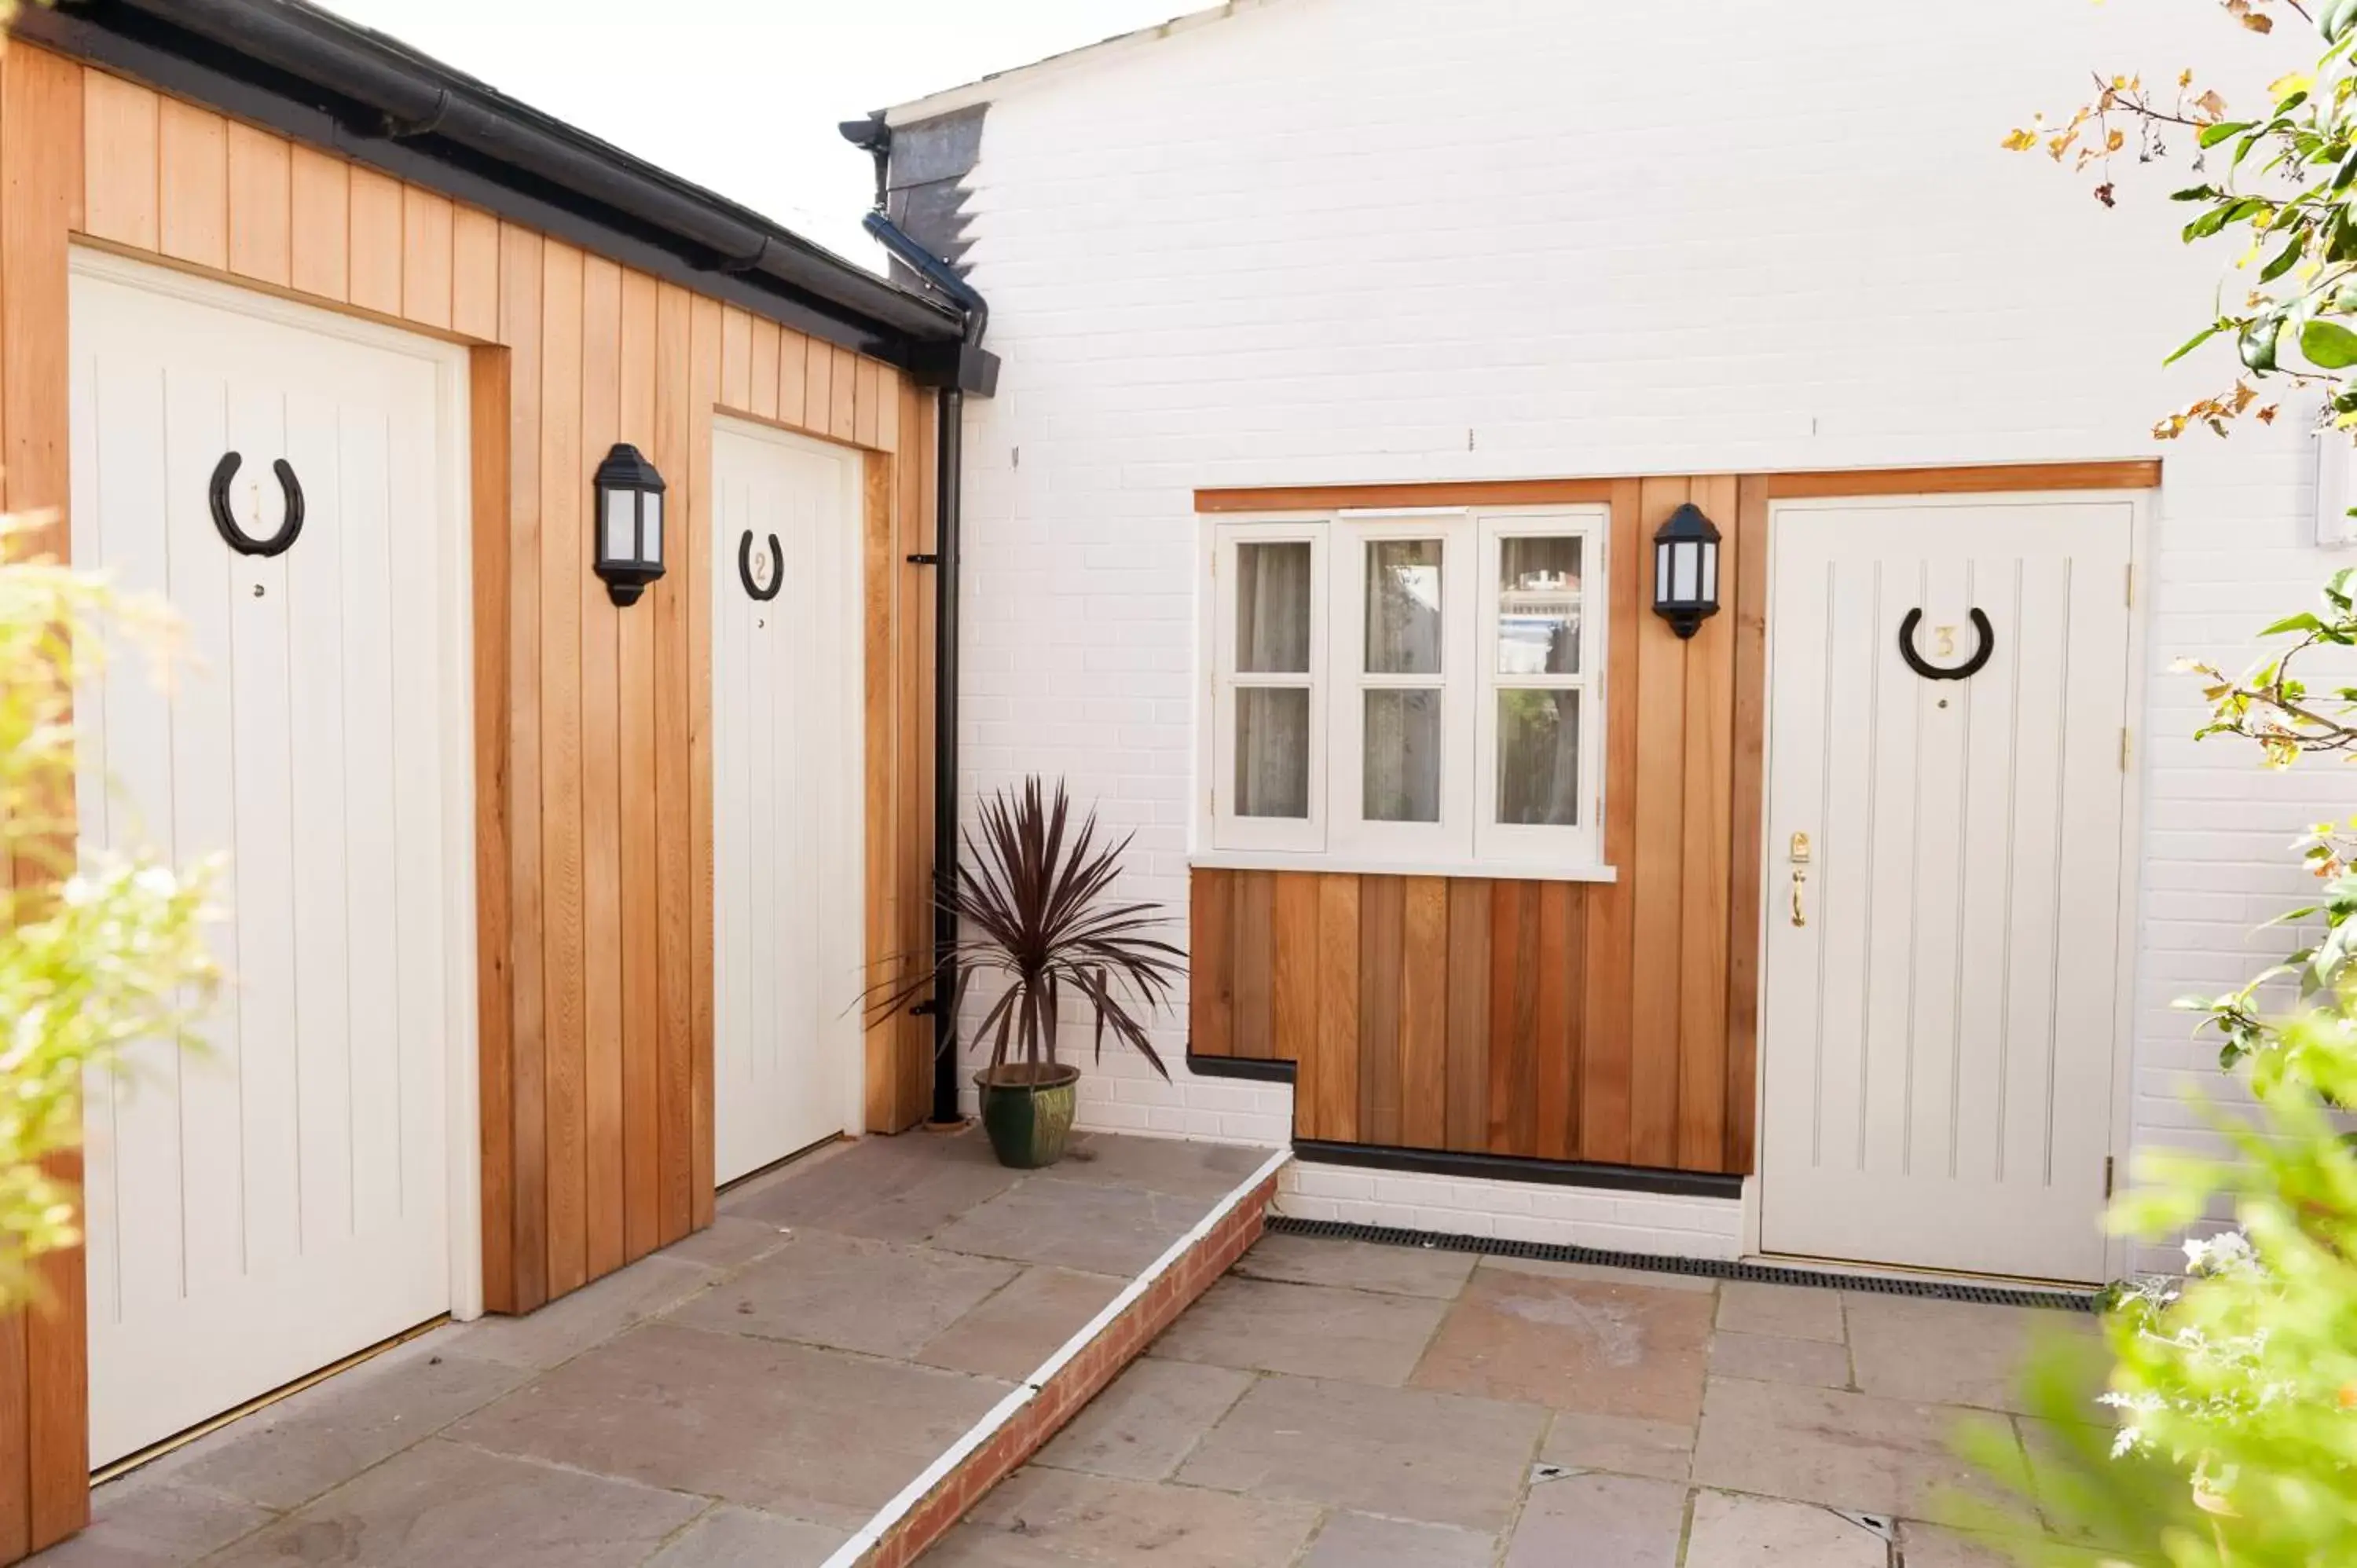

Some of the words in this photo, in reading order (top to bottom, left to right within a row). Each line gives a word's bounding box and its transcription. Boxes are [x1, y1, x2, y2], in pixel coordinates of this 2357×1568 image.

[249, 479, 262, 524] 1
[755, 552, 766, 581] 2
[1934, 626, 1956, 658] 3
